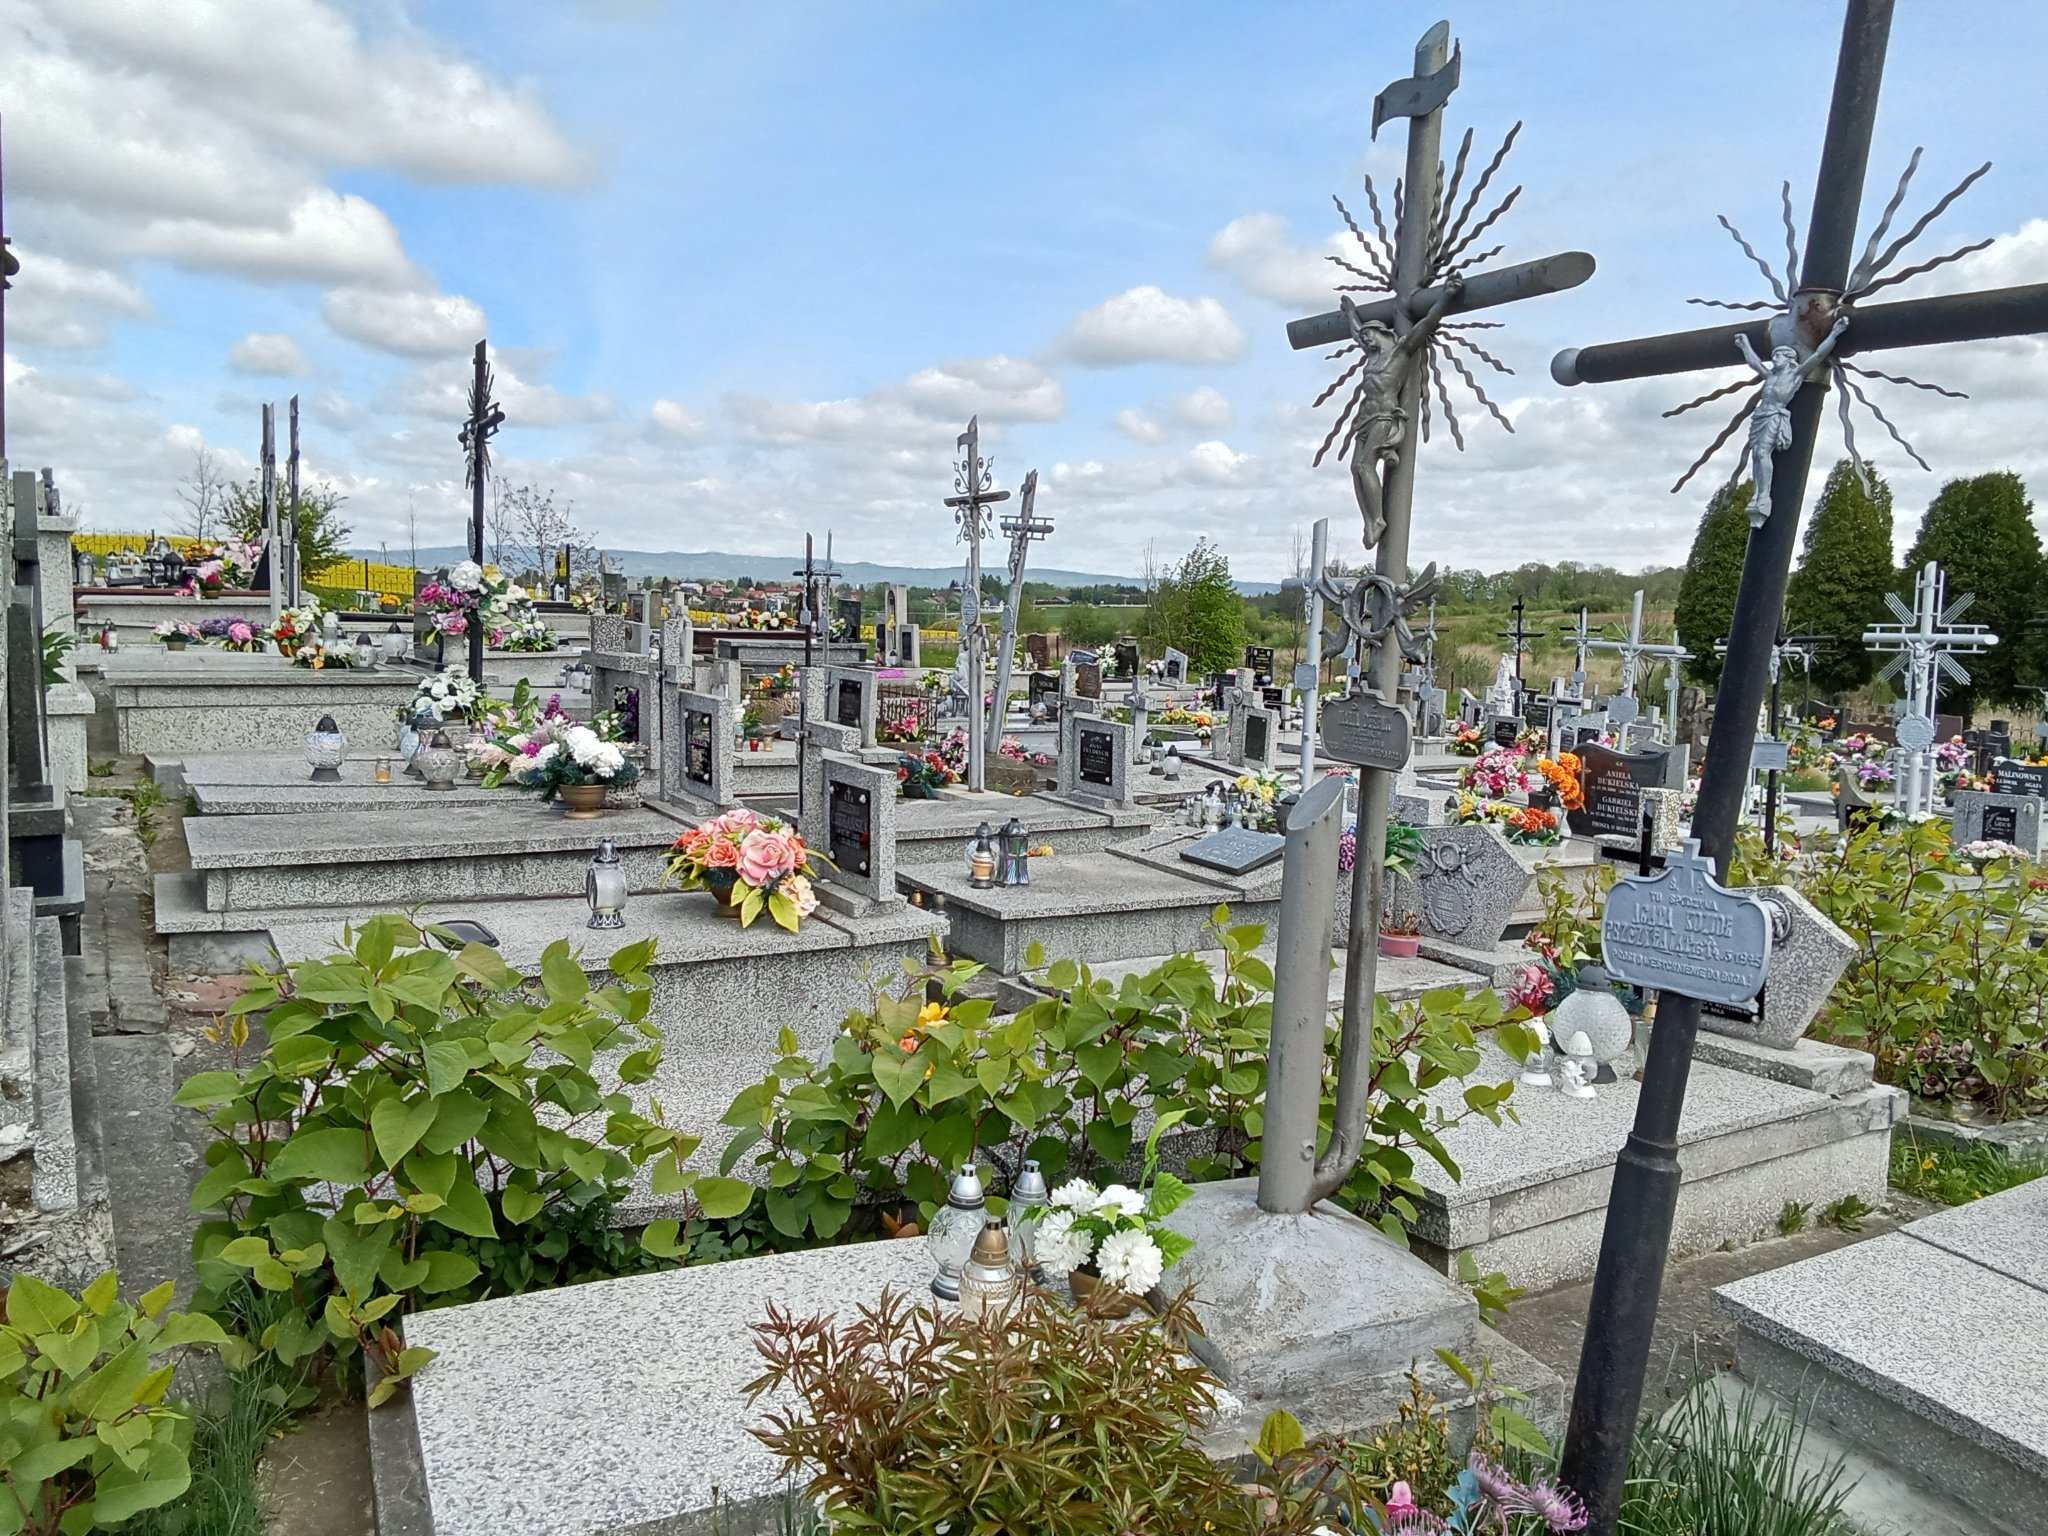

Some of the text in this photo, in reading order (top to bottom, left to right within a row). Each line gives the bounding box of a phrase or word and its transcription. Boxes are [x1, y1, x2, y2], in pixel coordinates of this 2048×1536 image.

[1606, 770, 1631, 780] ANIELA
[1997, 770, 2043, 781] MALINOWSCY
[1597, 777, 1640, 790] BUKIELSKA
[1602, 796, 1633, 806] GABRIEL
[1650, 892, 1663, 903] TU
[1632, 903, 1673, 929] AGATA
